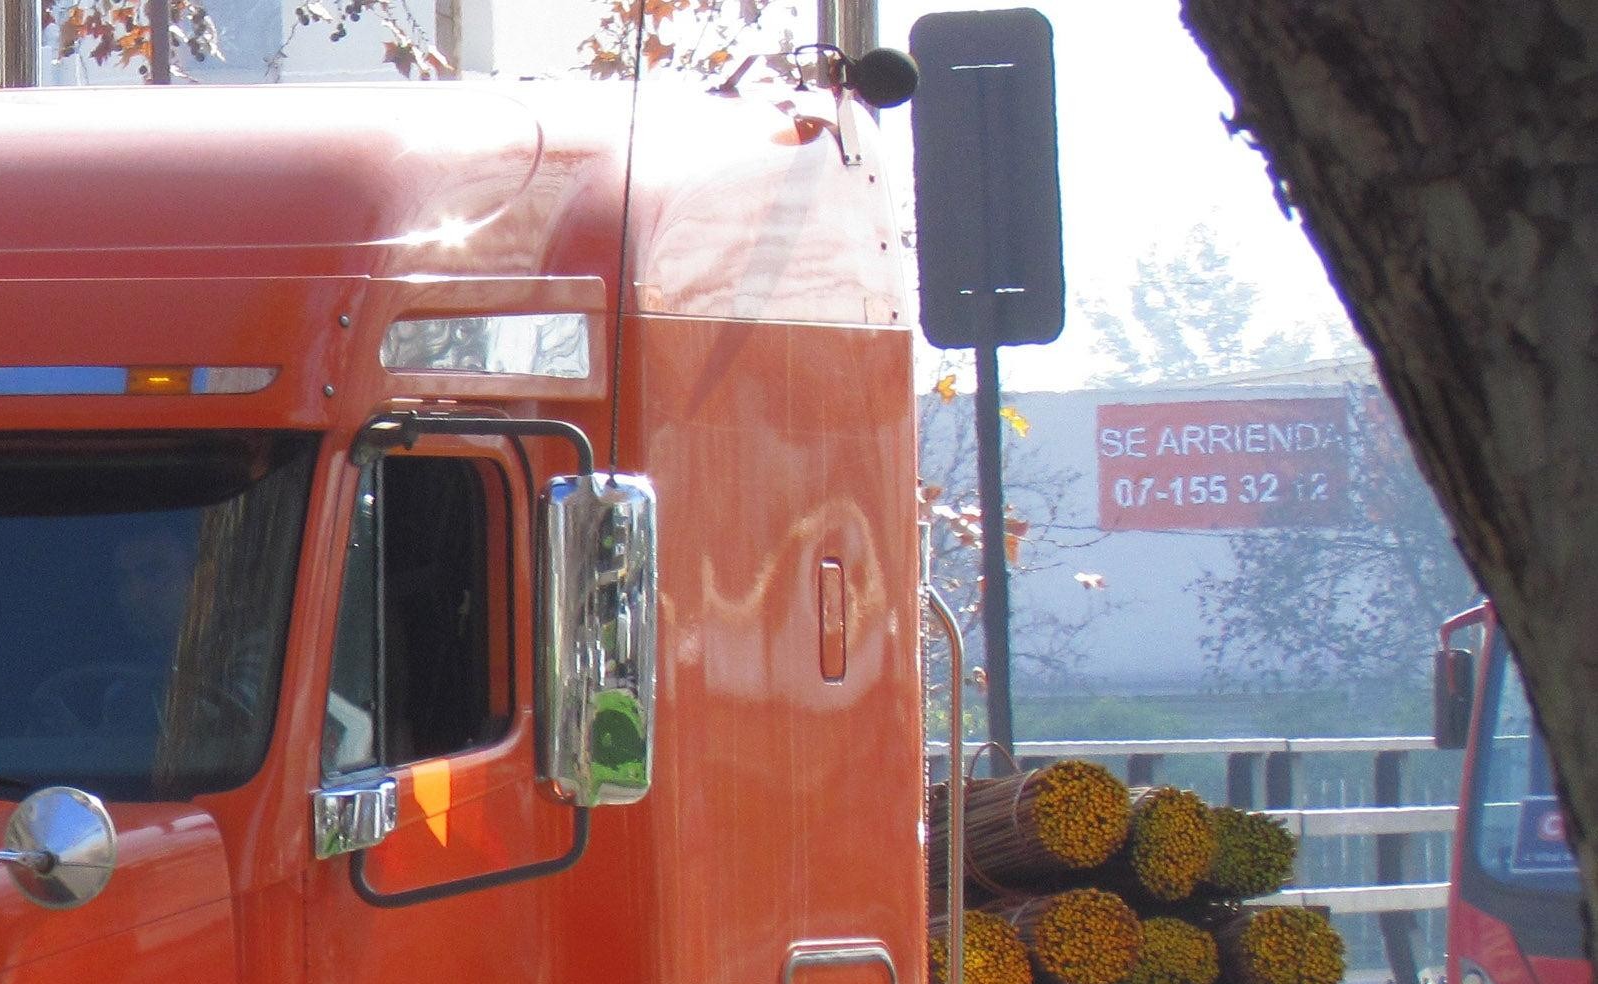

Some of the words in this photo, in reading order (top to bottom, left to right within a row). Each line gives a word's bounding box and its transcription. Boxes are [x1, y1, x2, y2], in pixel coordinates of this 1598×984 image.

[1100, 426, 1147, 458] SE
[1154, 422, 1343, 456] ARRIENDA
[1112, 474, 1228, 507] 07-155
[1238, 473, 1280, 504] 32
